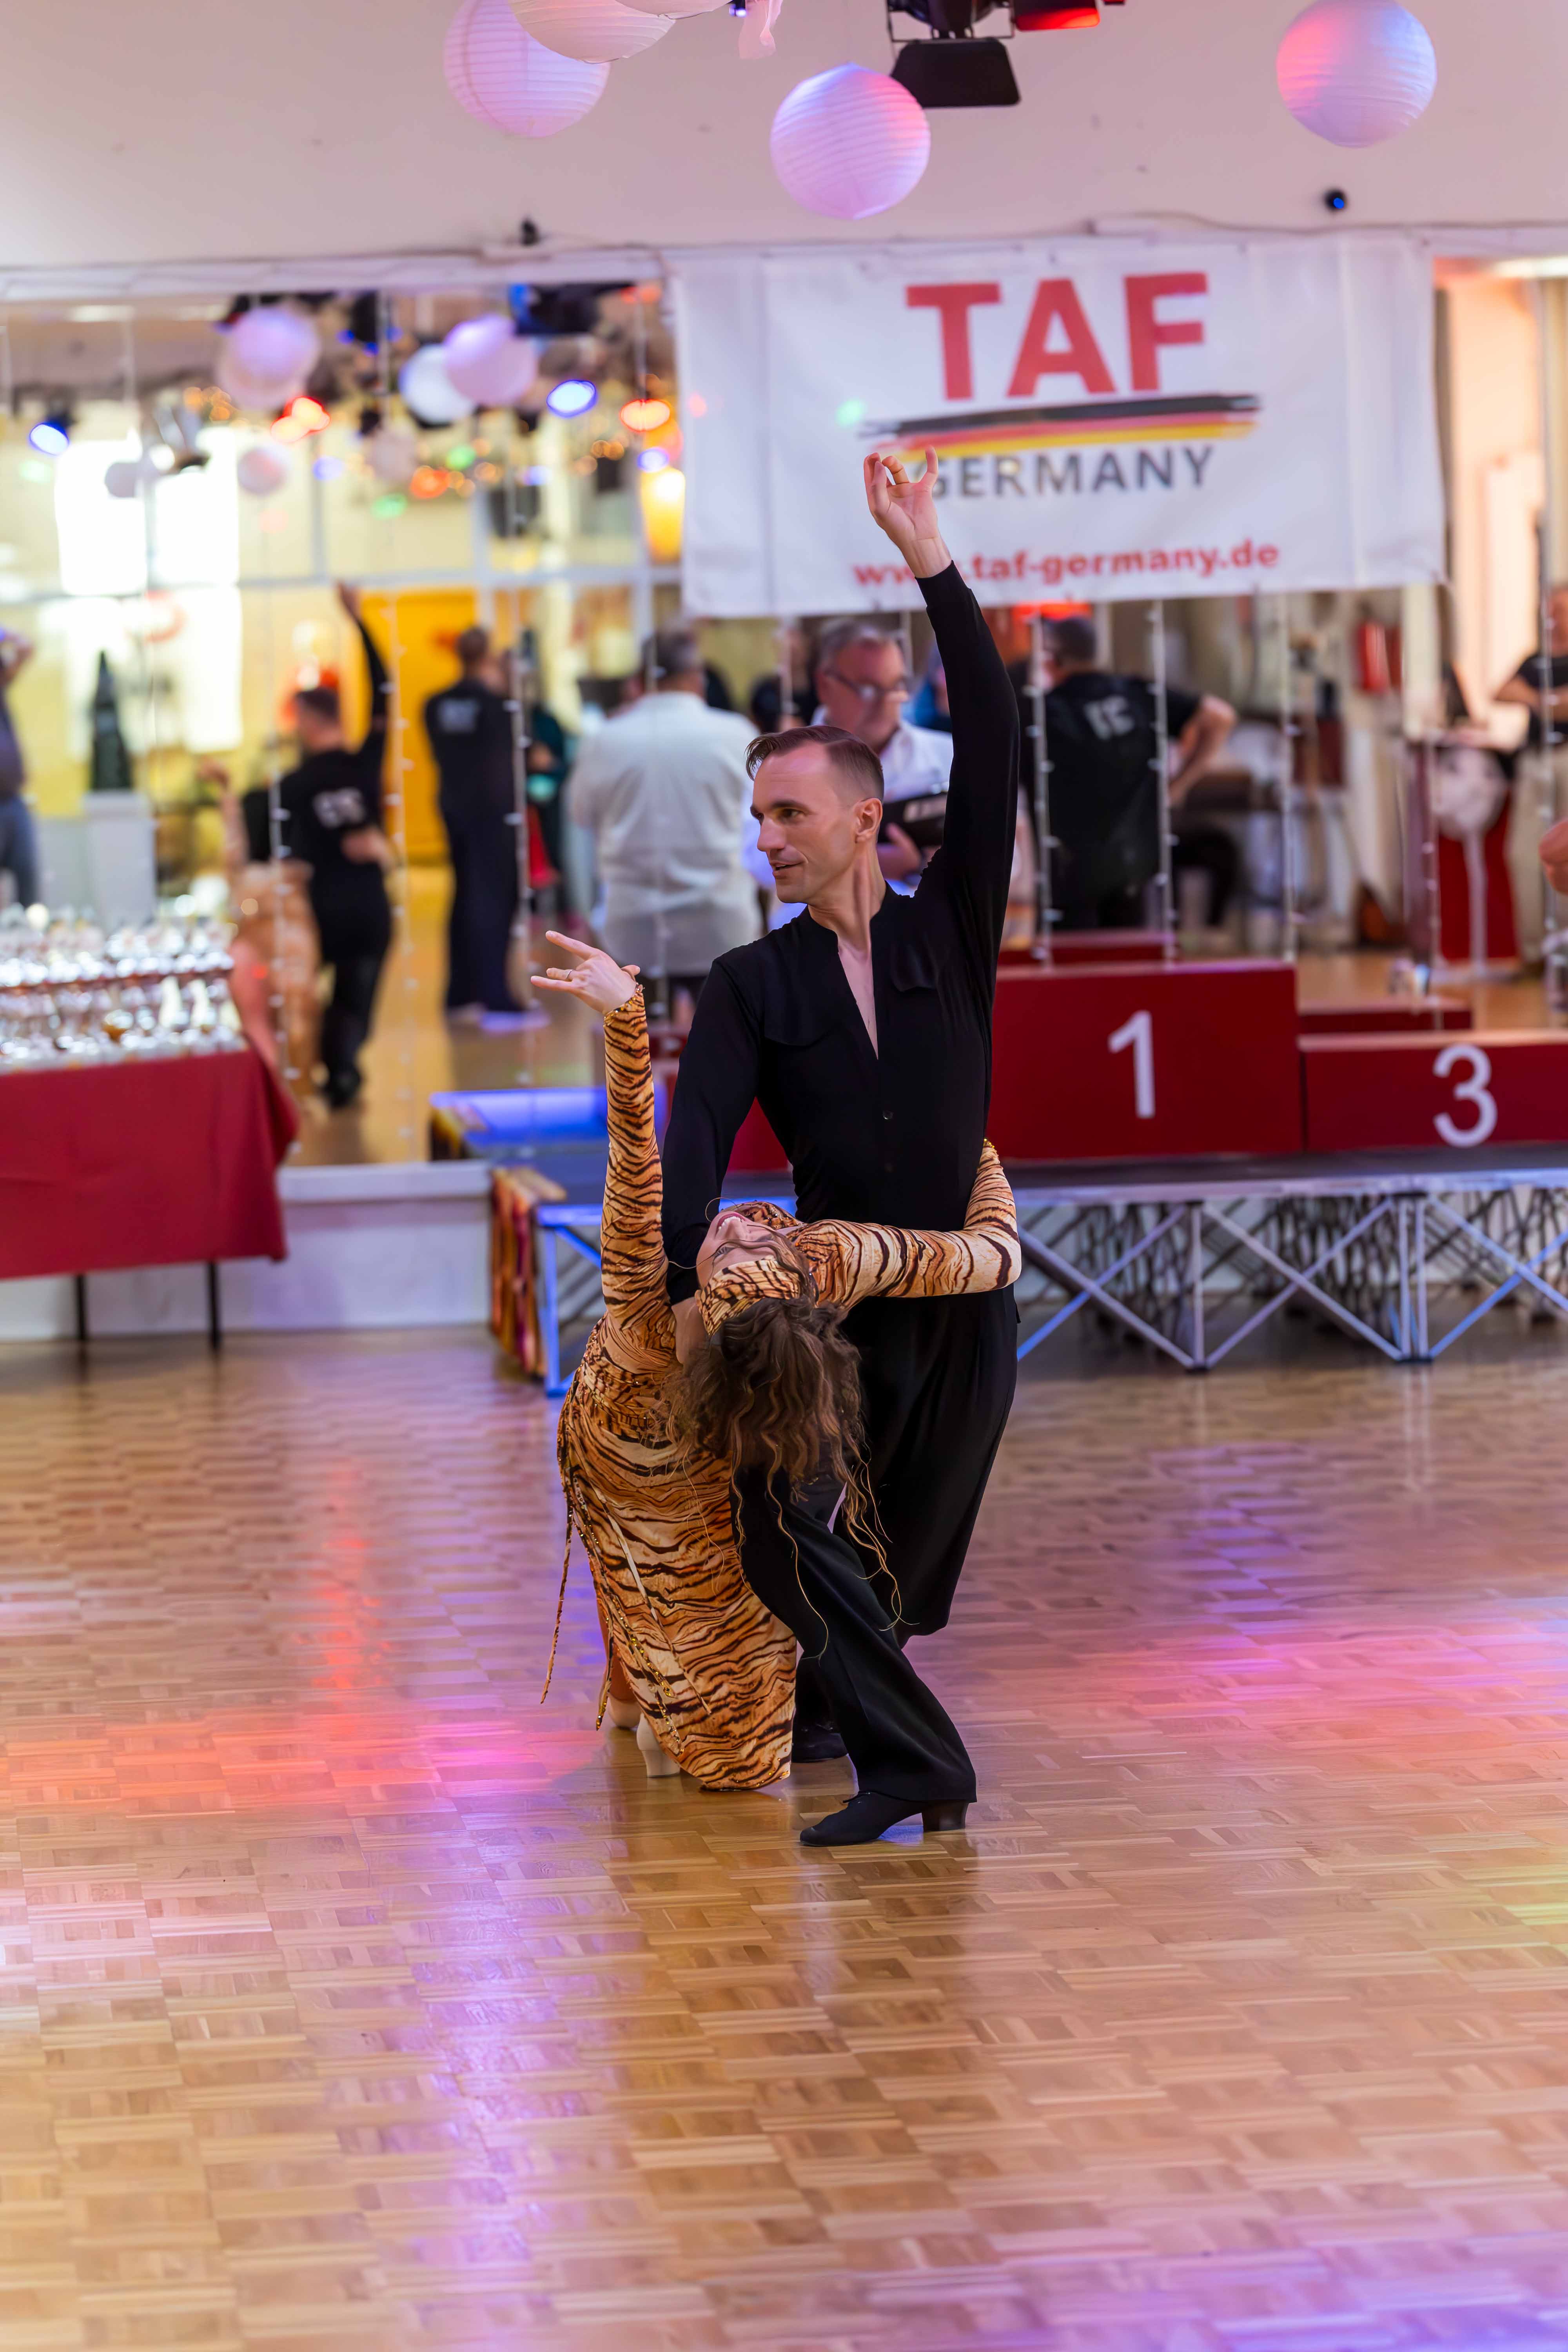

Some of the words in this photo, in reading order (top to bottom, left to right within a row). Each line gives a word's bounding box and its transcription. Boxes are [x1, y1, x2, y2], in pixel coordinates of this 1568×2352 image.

[905, 272, 1208, 401] TAF
[913, 445, 1212, 498] GERMANY
[853, 538, 1279, 586] ww.taf-germany.de
[1108, 1009, 1156, 1119] 1
[1433, 1043, 1498, 1148] 3
